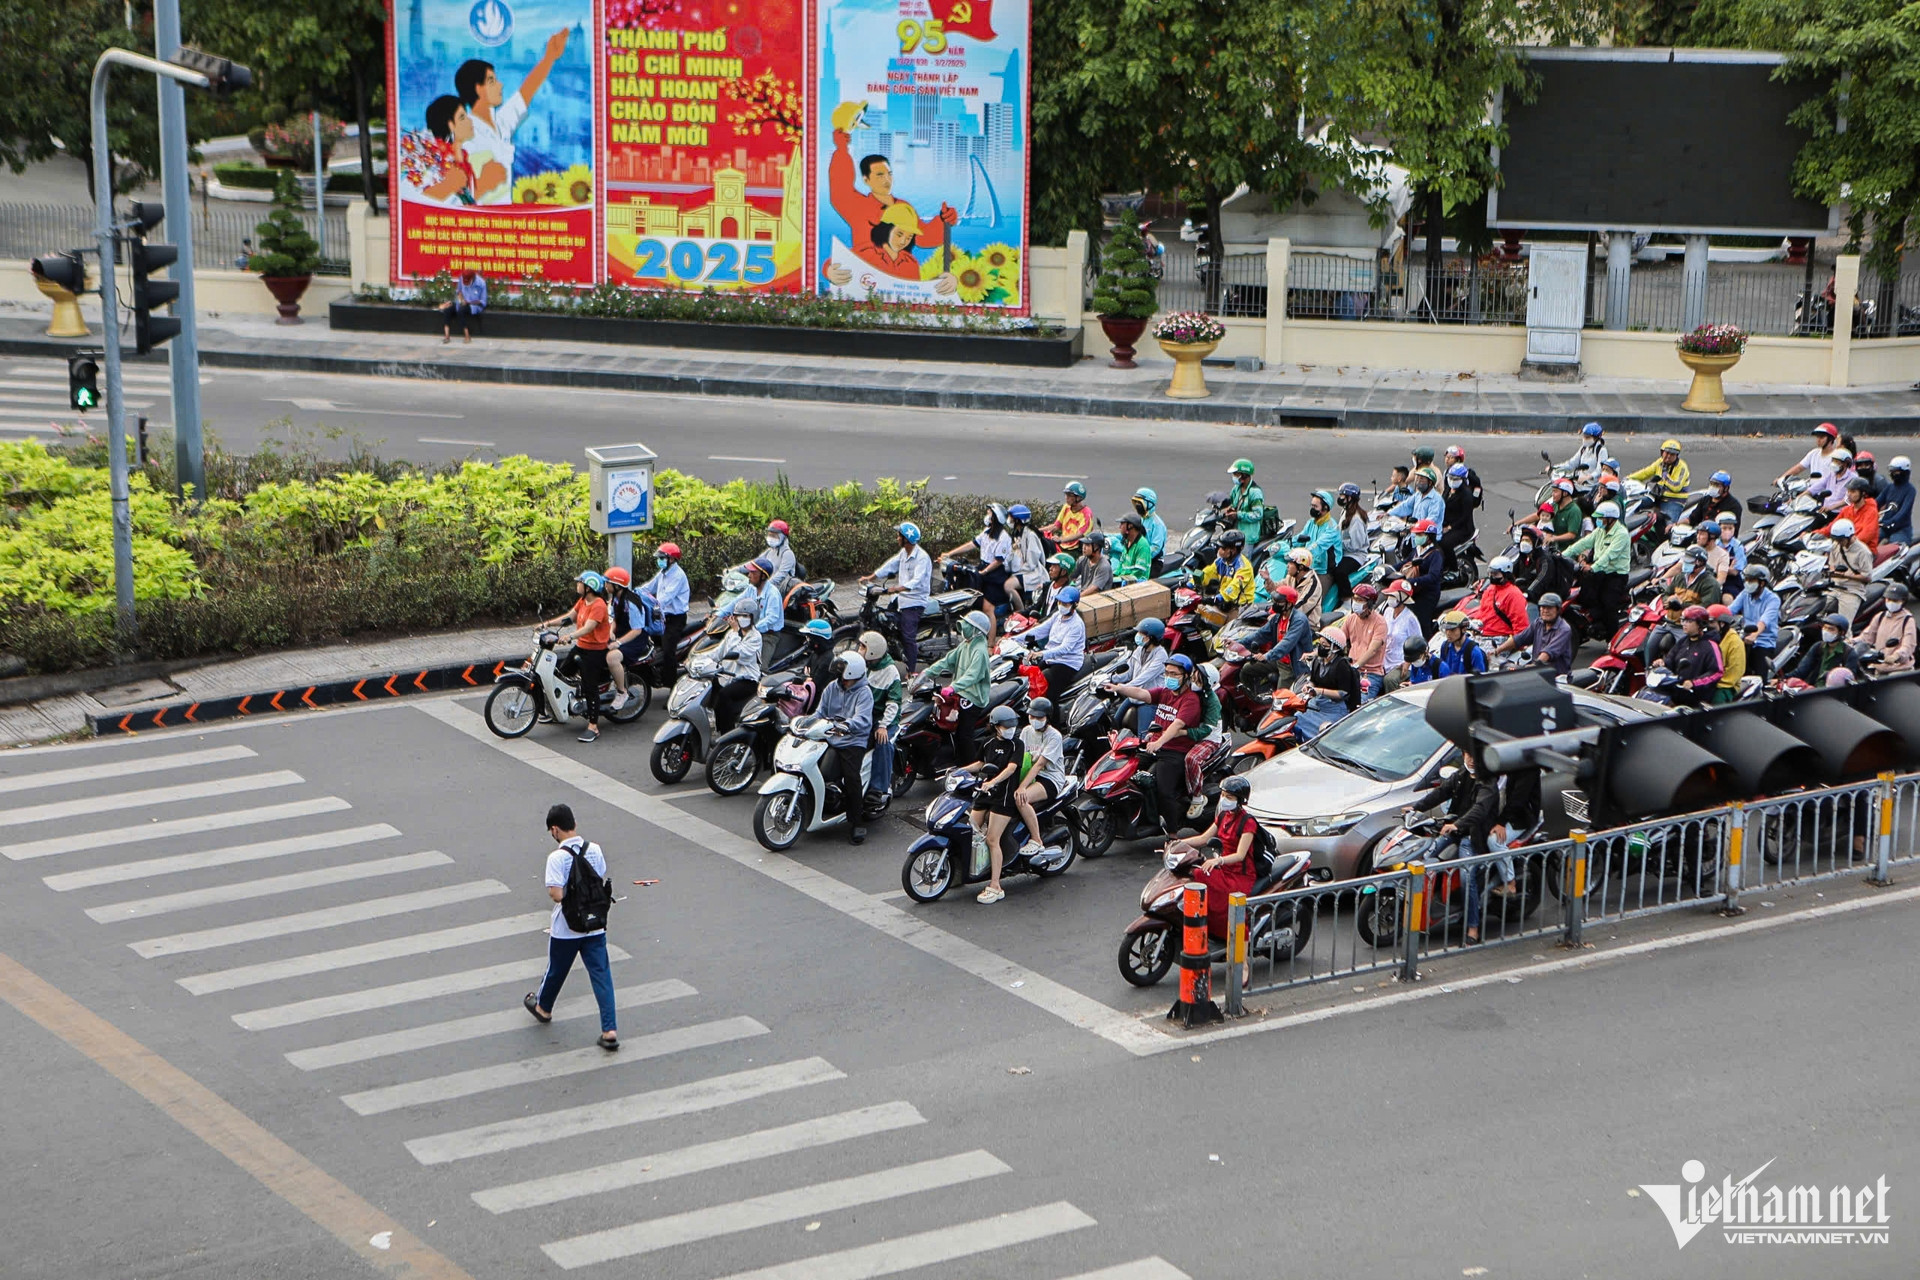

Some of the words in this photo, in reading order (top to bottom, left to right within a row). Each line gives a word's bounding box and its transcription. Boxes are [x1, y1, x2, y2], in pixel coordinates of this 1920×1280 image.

[608, 26, 678, 50] THÀNH
[684, 27, 729, 52] PHỐ
[897, 18, 948, 55] 95
[610, 50, 639, 74] HỒ
[644, 53, 682, 75] CHÍ
[686, 56, 743, 78] MINH
[948, 46, 964, 56] NĂM
[610, 74, 655, 98] HÂN
[660, 79, 718, 100] HOAN
[867, 83, 890, 94] ĐẢNG
[893, 83, 916, 95] CỘNG
[917, 84, 936, 96] SẢN
[938, 82, 956, 96] VIỆT
[958, 86, 979, 96] NAM
[888, 70, 910, 81] NGÀY
[913, 70, 940, 82] THÀNH
[943, 72, 958, 84] LẬP
[610, 98, 667, 122] CHÀO
[672, 99, 716, 124] ĐÓN
[612, 120, 662, 144] NĂM
[667, 123, 708, 146] MỚI
[513, 218, 526, 230] PHỐ
[550, 222, 568, 232] MINH
[634, 239, 778, 285] 2025
